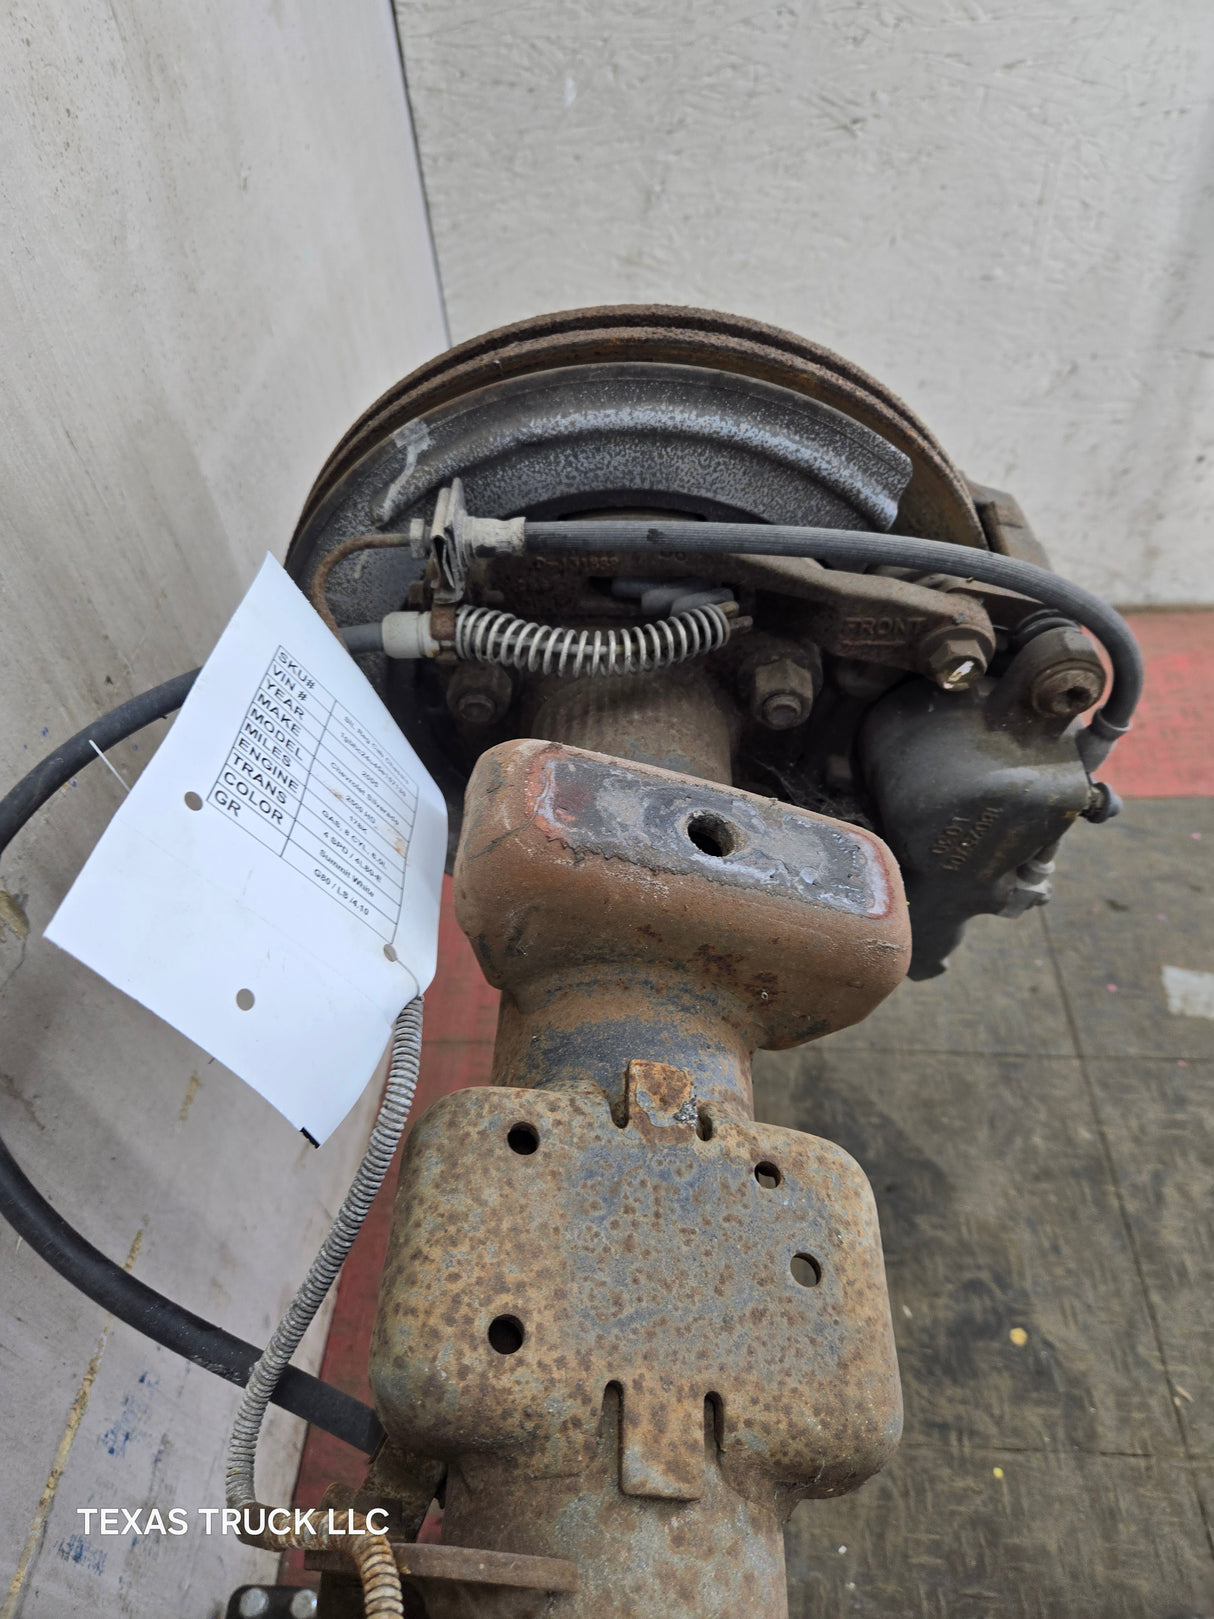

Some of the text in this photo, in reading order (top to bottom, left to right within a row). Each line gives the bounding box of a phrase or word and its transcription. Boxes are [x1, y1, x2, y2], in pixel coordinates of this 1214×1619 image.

[273, 665, 307, 701] VIN #
[278, 652, 316, 690] SKU#
[257, 693, 301, 737] MAKE
[266, 678, 305, 720] YEAR
[244, 723, 291, 767] MILES
[250, 708, 303, 761] MODEL
[233, 752, 287, 804] TRANS
[238, 738, 299, 793] ENGINE
[214, 790, 241, 817] GR
[224, 771, 284, 825] COLOR
[330, 836, 349, 855] SPD
[320, 849, 375, 898] Summit White
